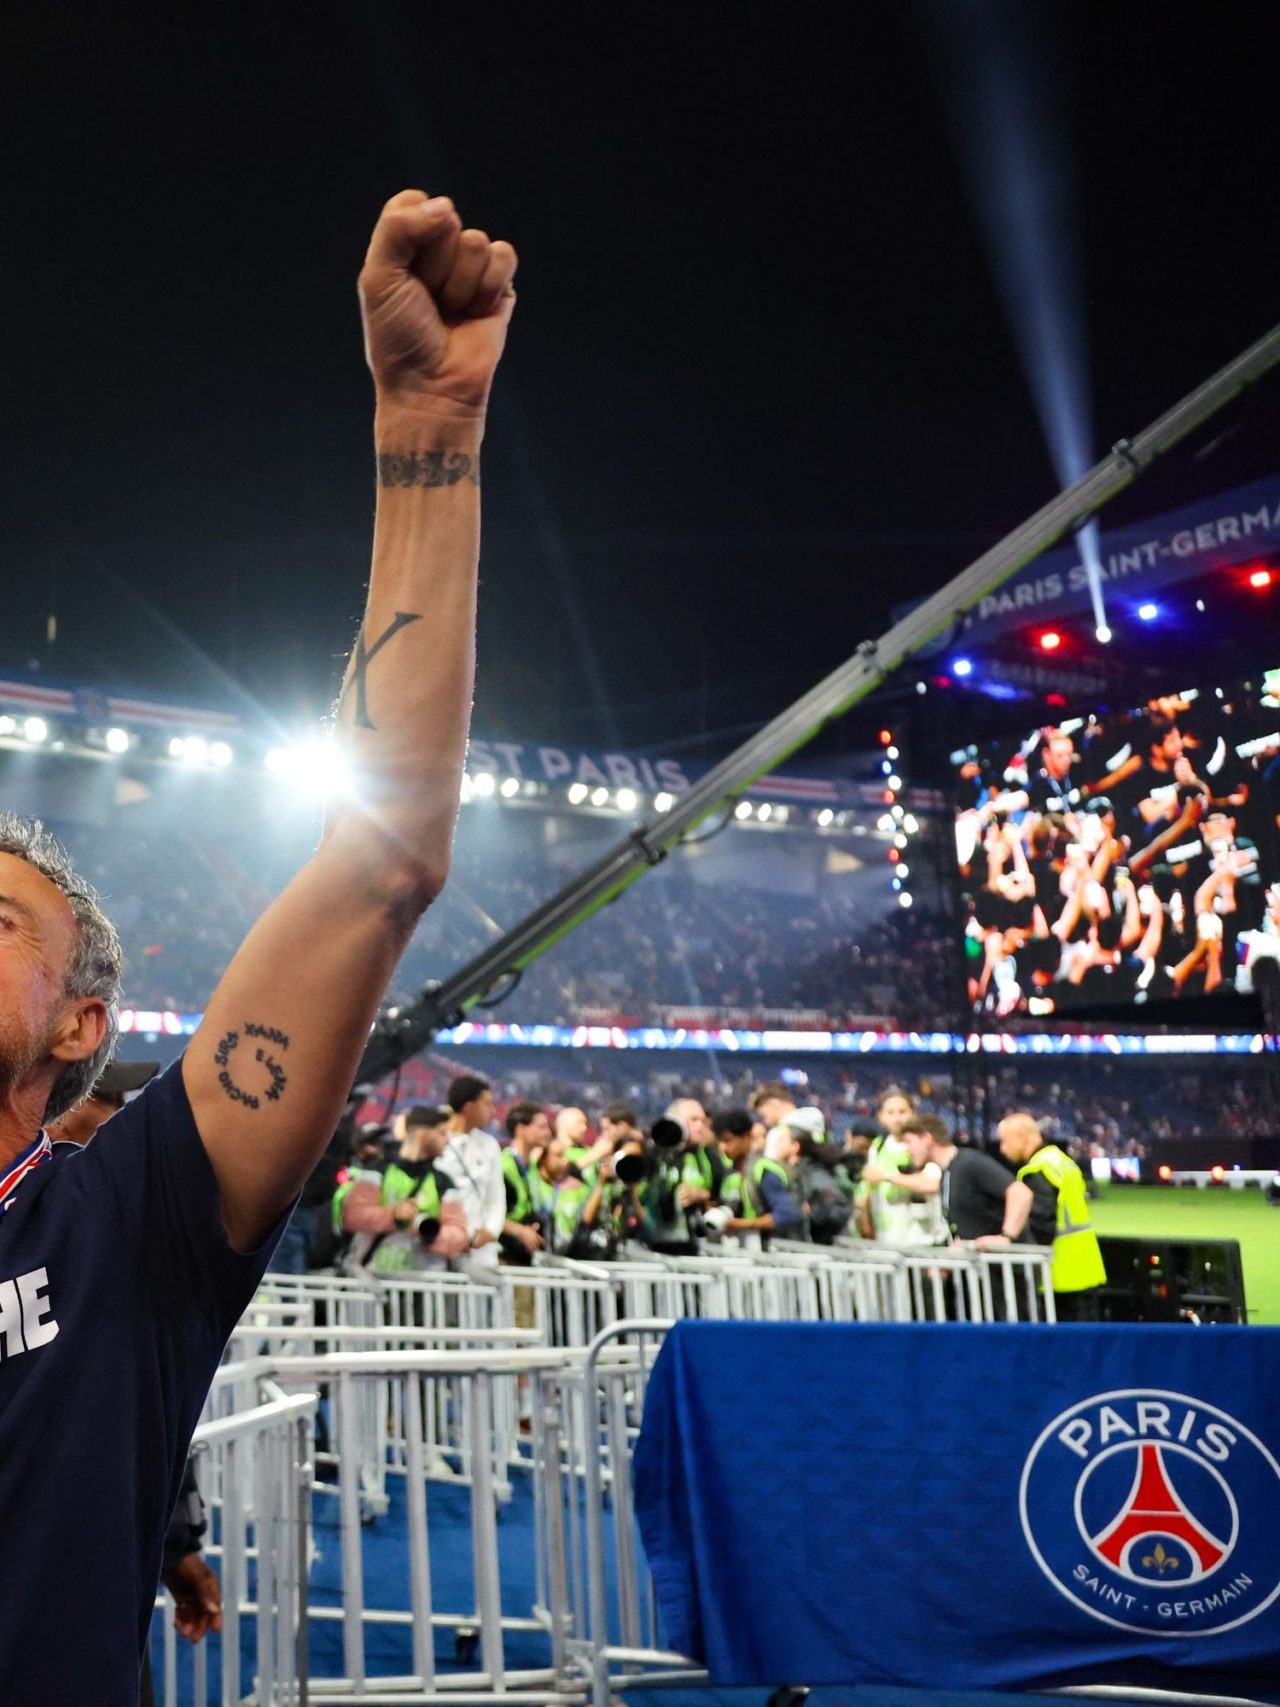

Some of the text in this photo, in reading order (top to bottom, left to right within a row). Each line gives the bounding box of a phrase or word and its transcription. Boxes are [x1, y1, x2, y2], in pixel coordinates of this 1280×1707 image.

[978, 503, 1280, 620] PARIS SAINT-GERM
[540, 746, 691, 796] PARIS
[1058, 1401, 1238, 1462] PARIS
[1072, 1563, 1137, 1610] SAINT
[1156, 1571, 1254, 1618] GERMAIN
